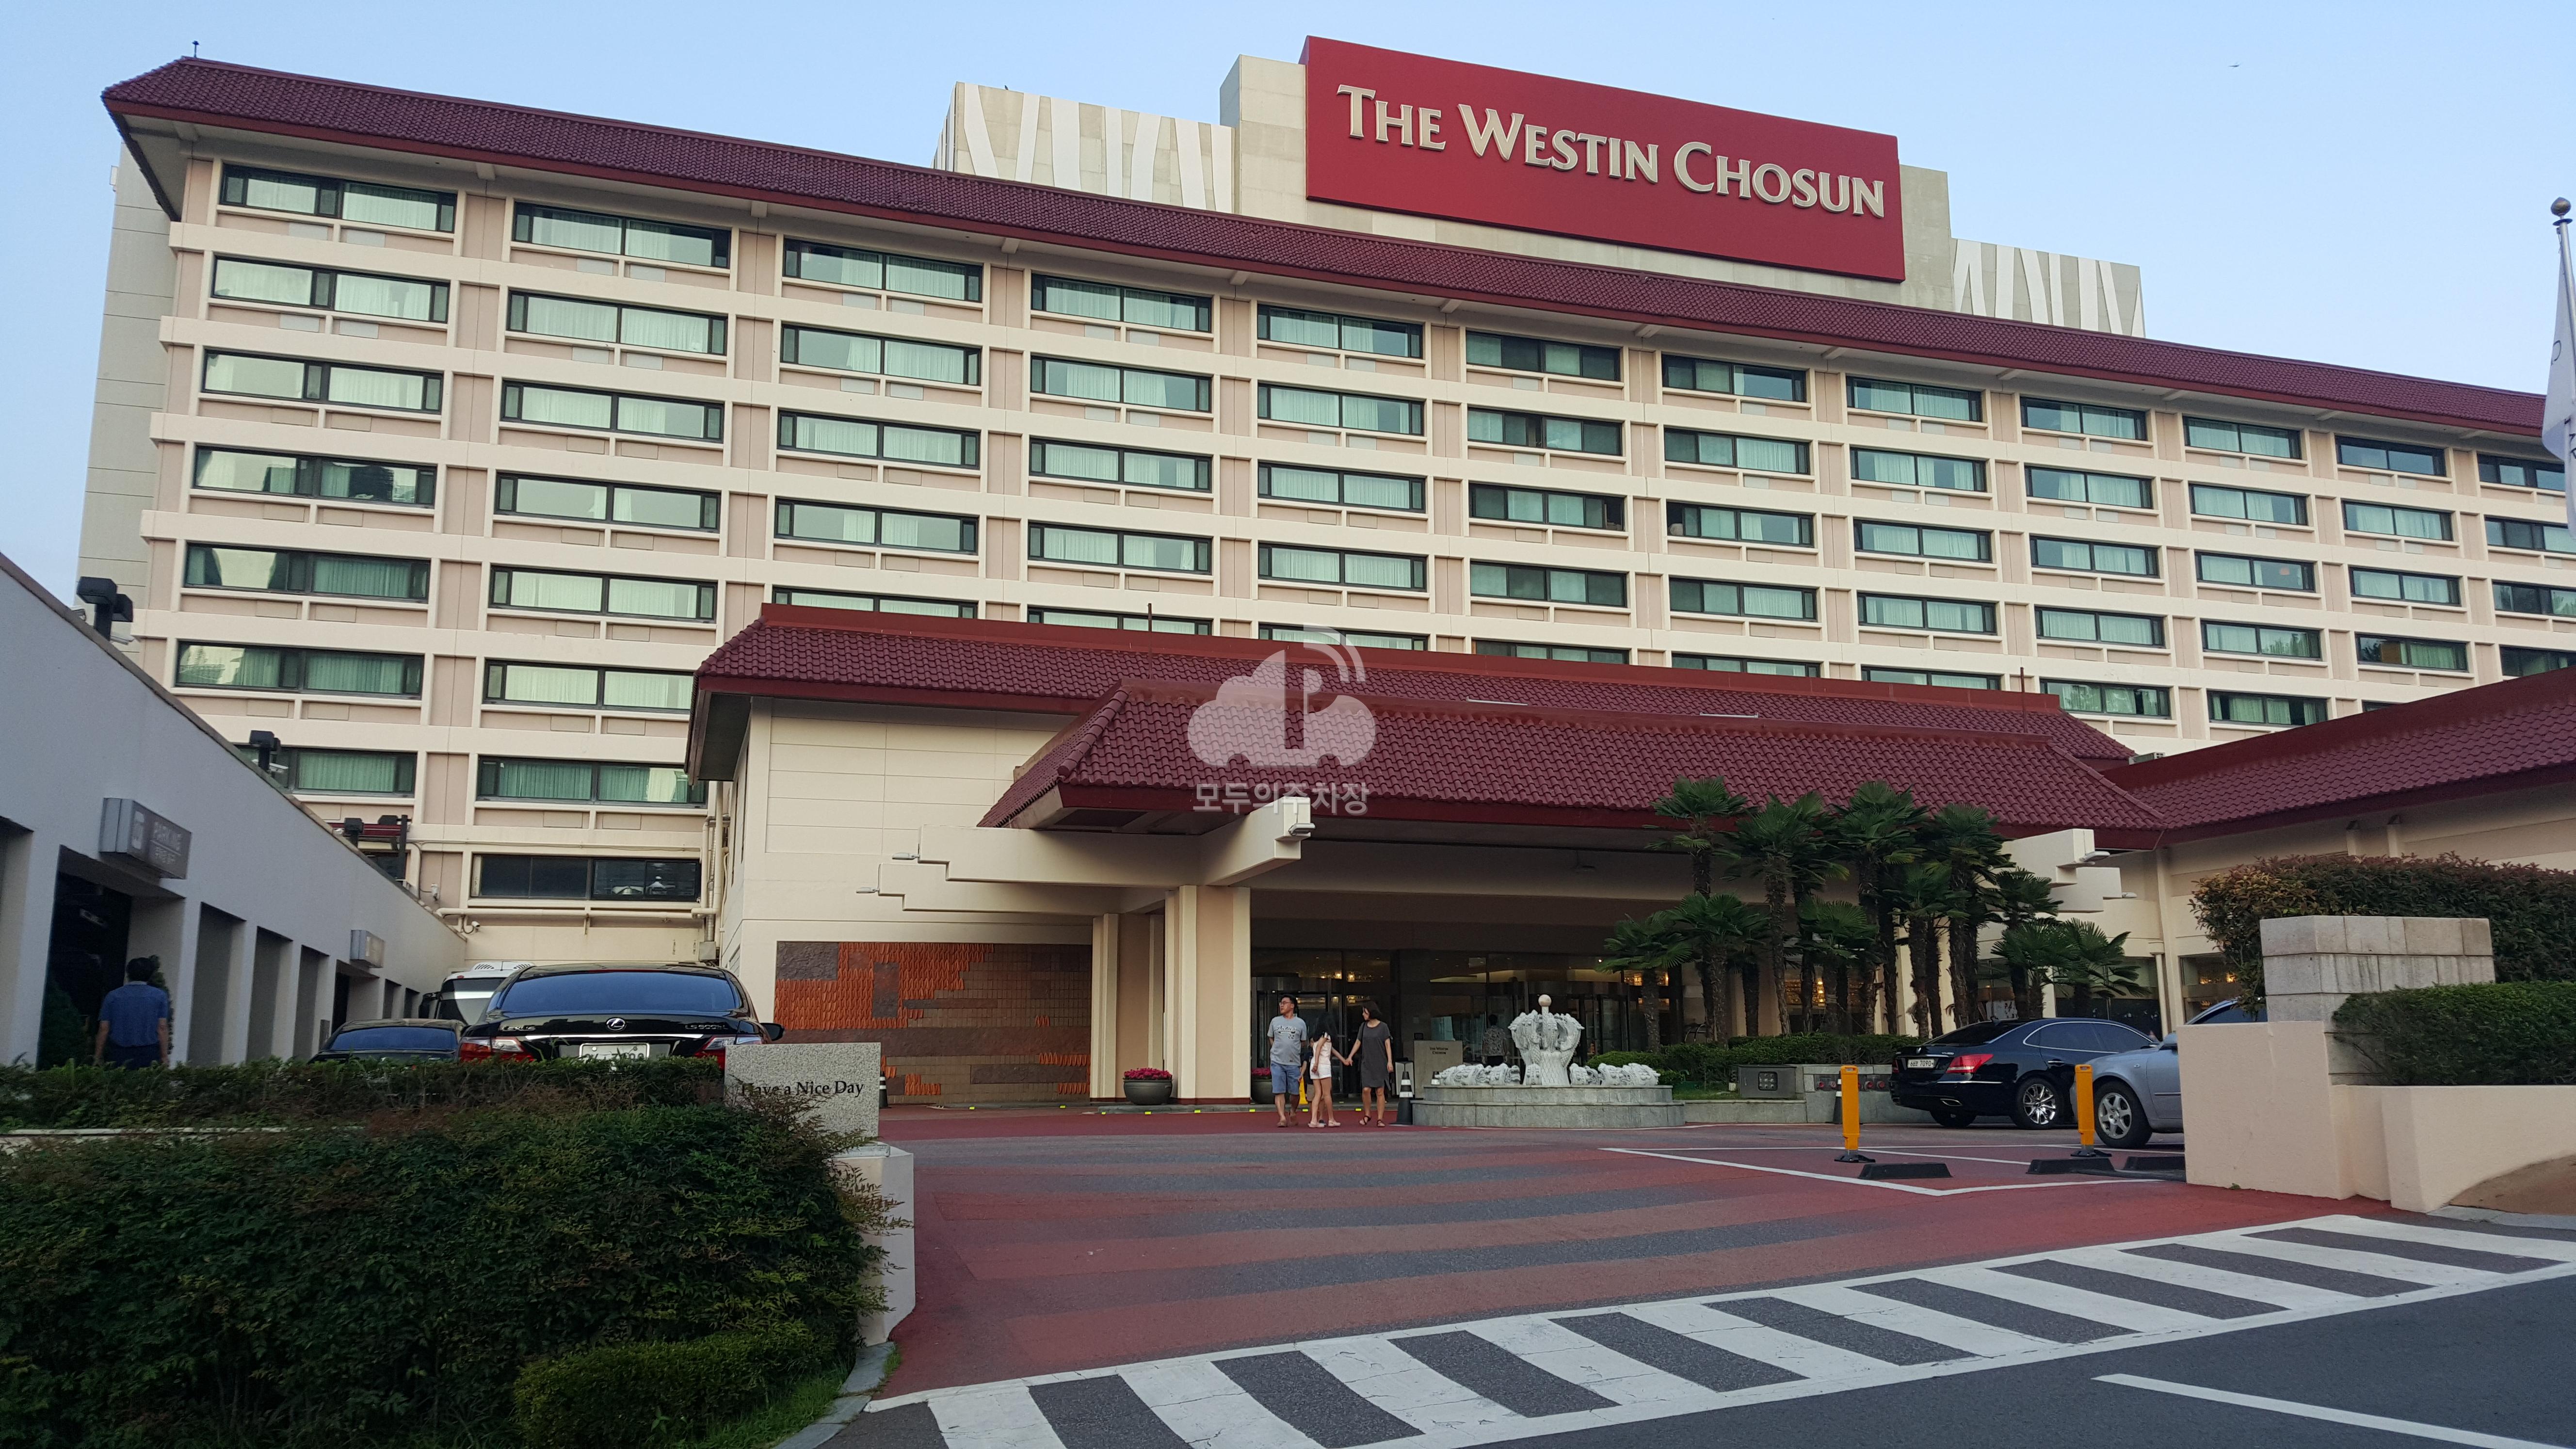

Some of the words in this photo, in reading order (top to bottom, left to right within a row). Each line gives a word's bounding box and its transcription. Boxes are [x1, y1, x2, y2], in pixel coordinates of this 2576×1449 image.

[1336, 84, 1446, 151] THE
[1457, 103, 1659, 184] WESTIN
[1674, 141, 1885, 218] CHOSUN
[784, 1086, 791, 1095] a
[794, 1081, 830, 1095] Nice
[834, 1080, 864, 1097] Day
